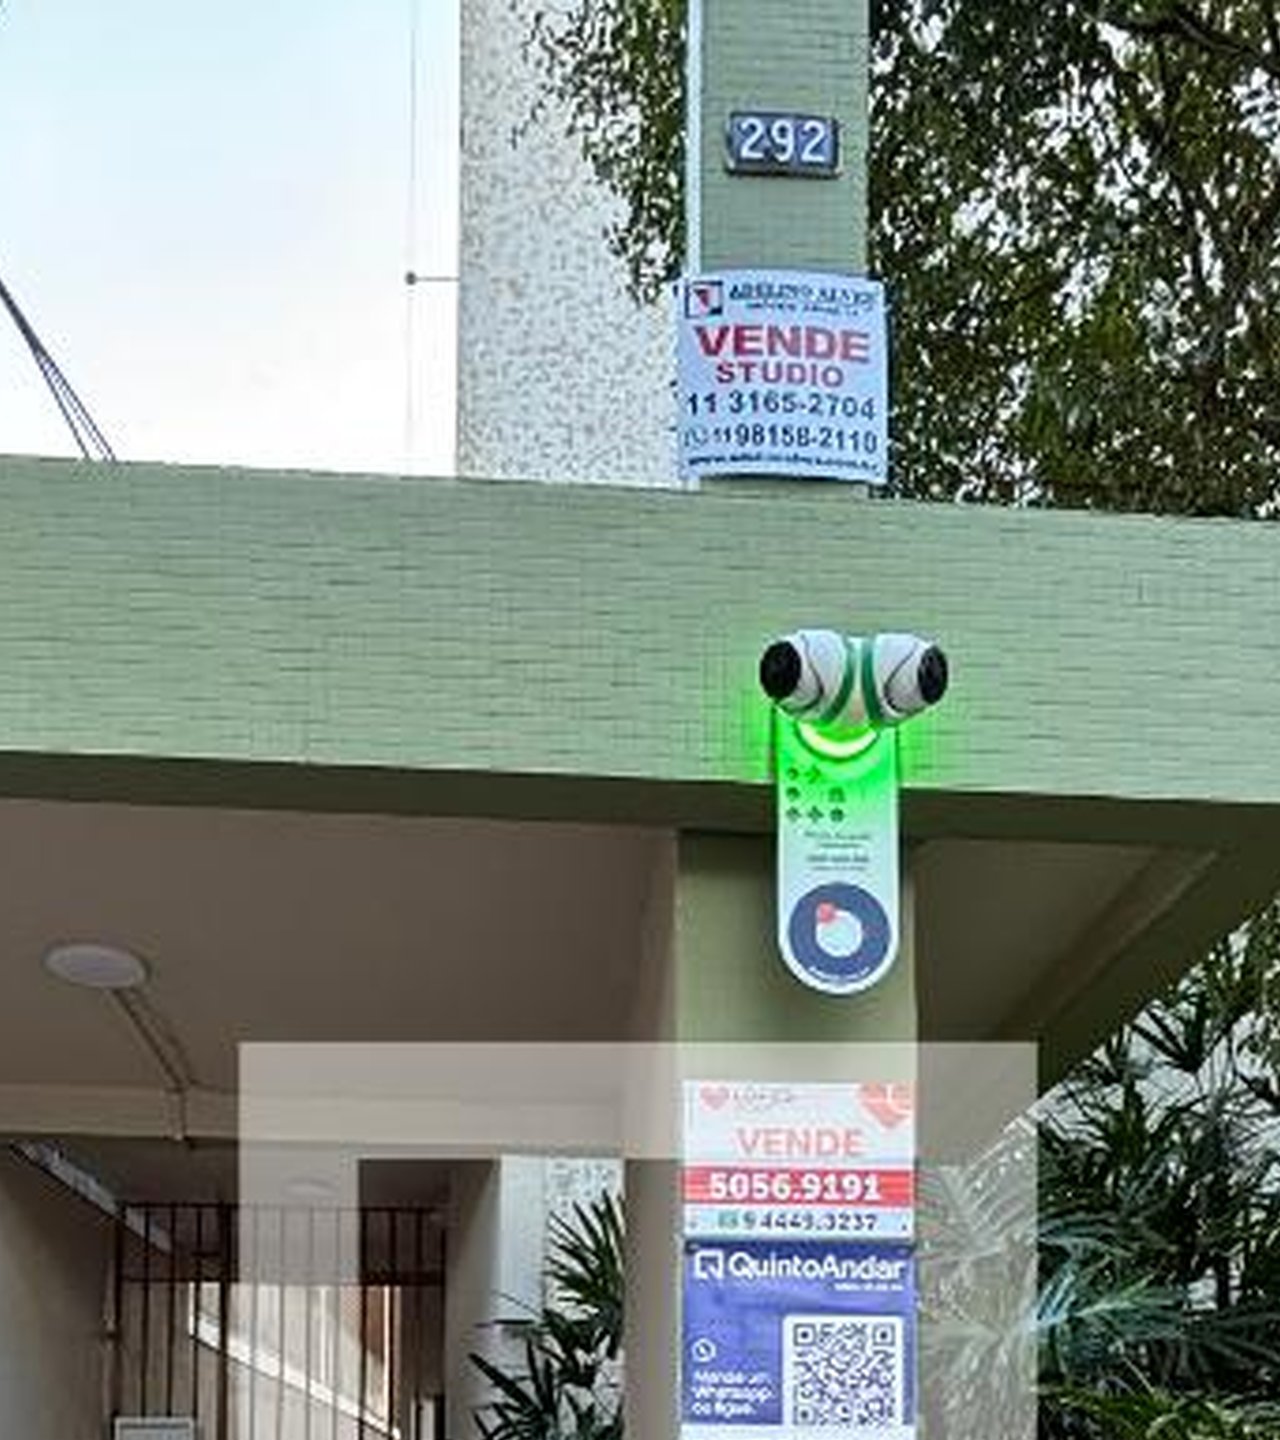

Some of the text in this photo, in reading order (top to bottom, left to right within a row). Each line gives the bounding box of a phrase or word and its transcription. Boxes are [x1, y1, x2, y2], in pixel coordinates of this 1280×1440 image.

[738, 117, 826, 163] 292
[694, 324, 871, 363] VENDE
[715, 362, 845, 388] STUDIO
[688, 388, 877, 421] 11 3165-2704
[736, 1127, 865, 1157] VENDE
[709, 1171, 883, 1201] 5056.9191
[728, 1251, 905, 1280] QuintoAndar
